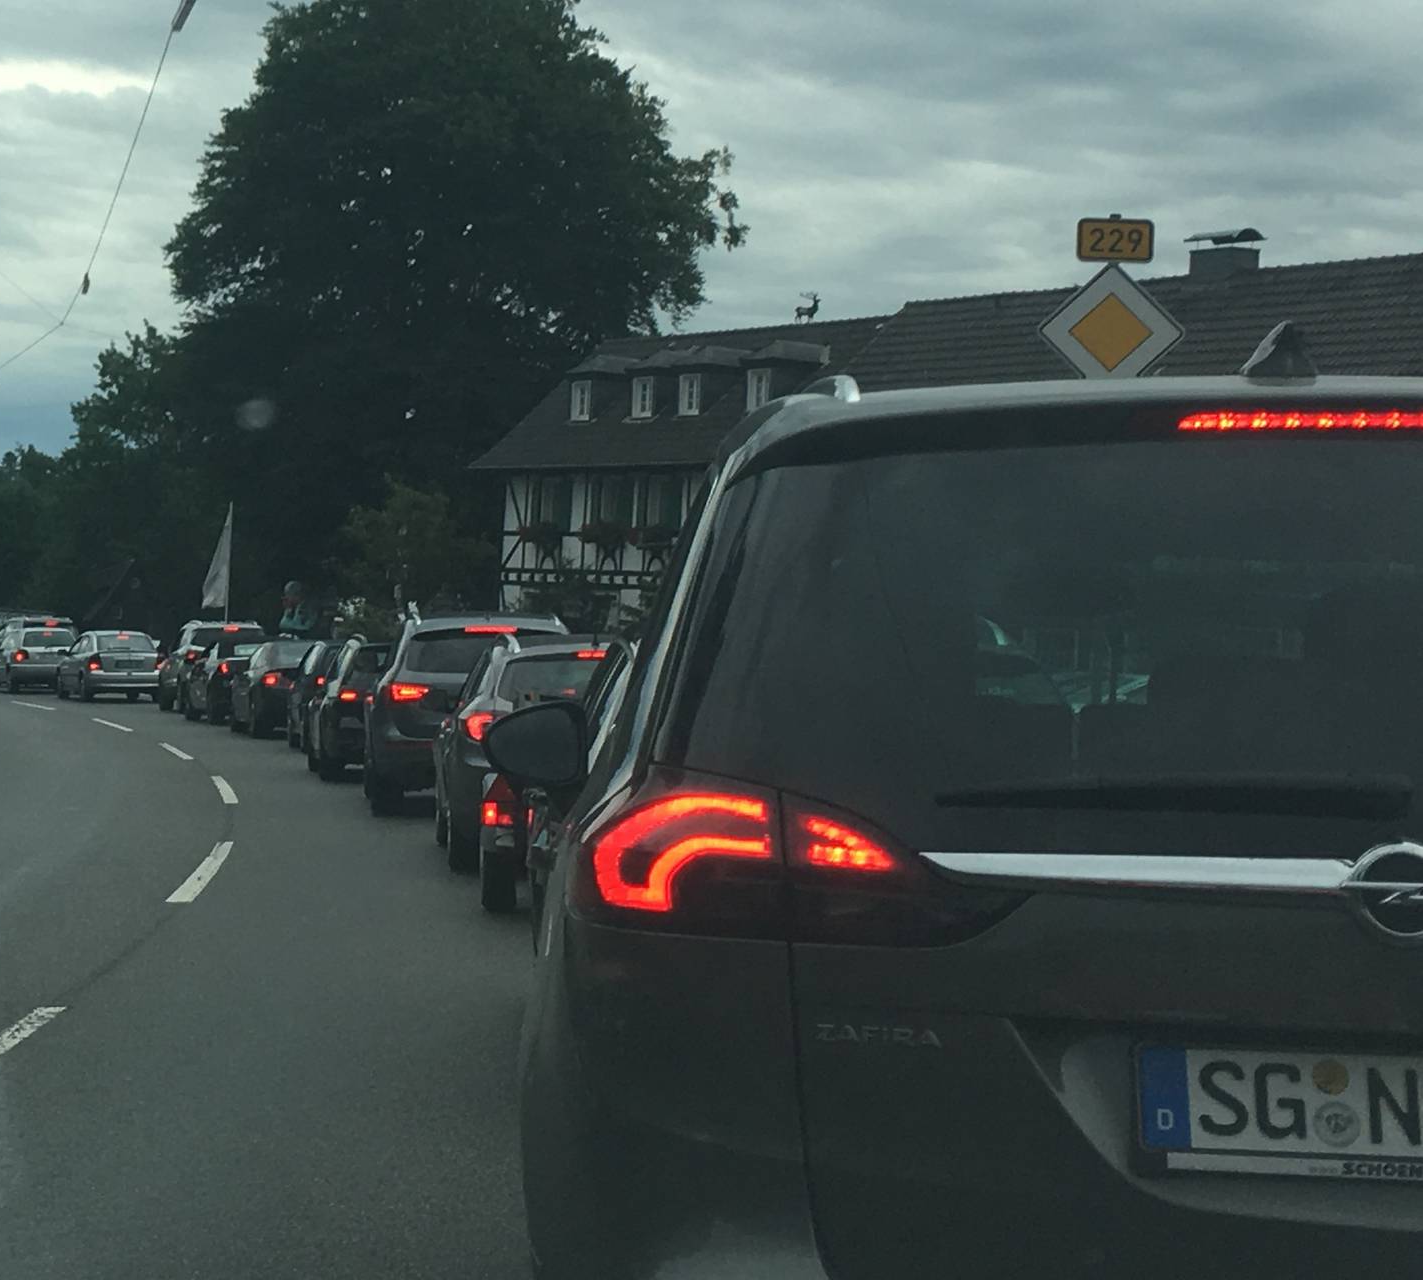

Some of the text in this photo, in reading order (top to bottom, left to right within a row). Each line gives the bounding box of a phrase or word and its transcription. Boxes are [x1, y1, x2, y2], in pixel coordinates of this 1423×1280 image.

[1089, 228, 1143, 253] 229
[816, 1023, 943, 1049] ZAFIRA
[1198, 1059, 1422, 1146] SG N
[1157, 1108, 1174, 1131] D
